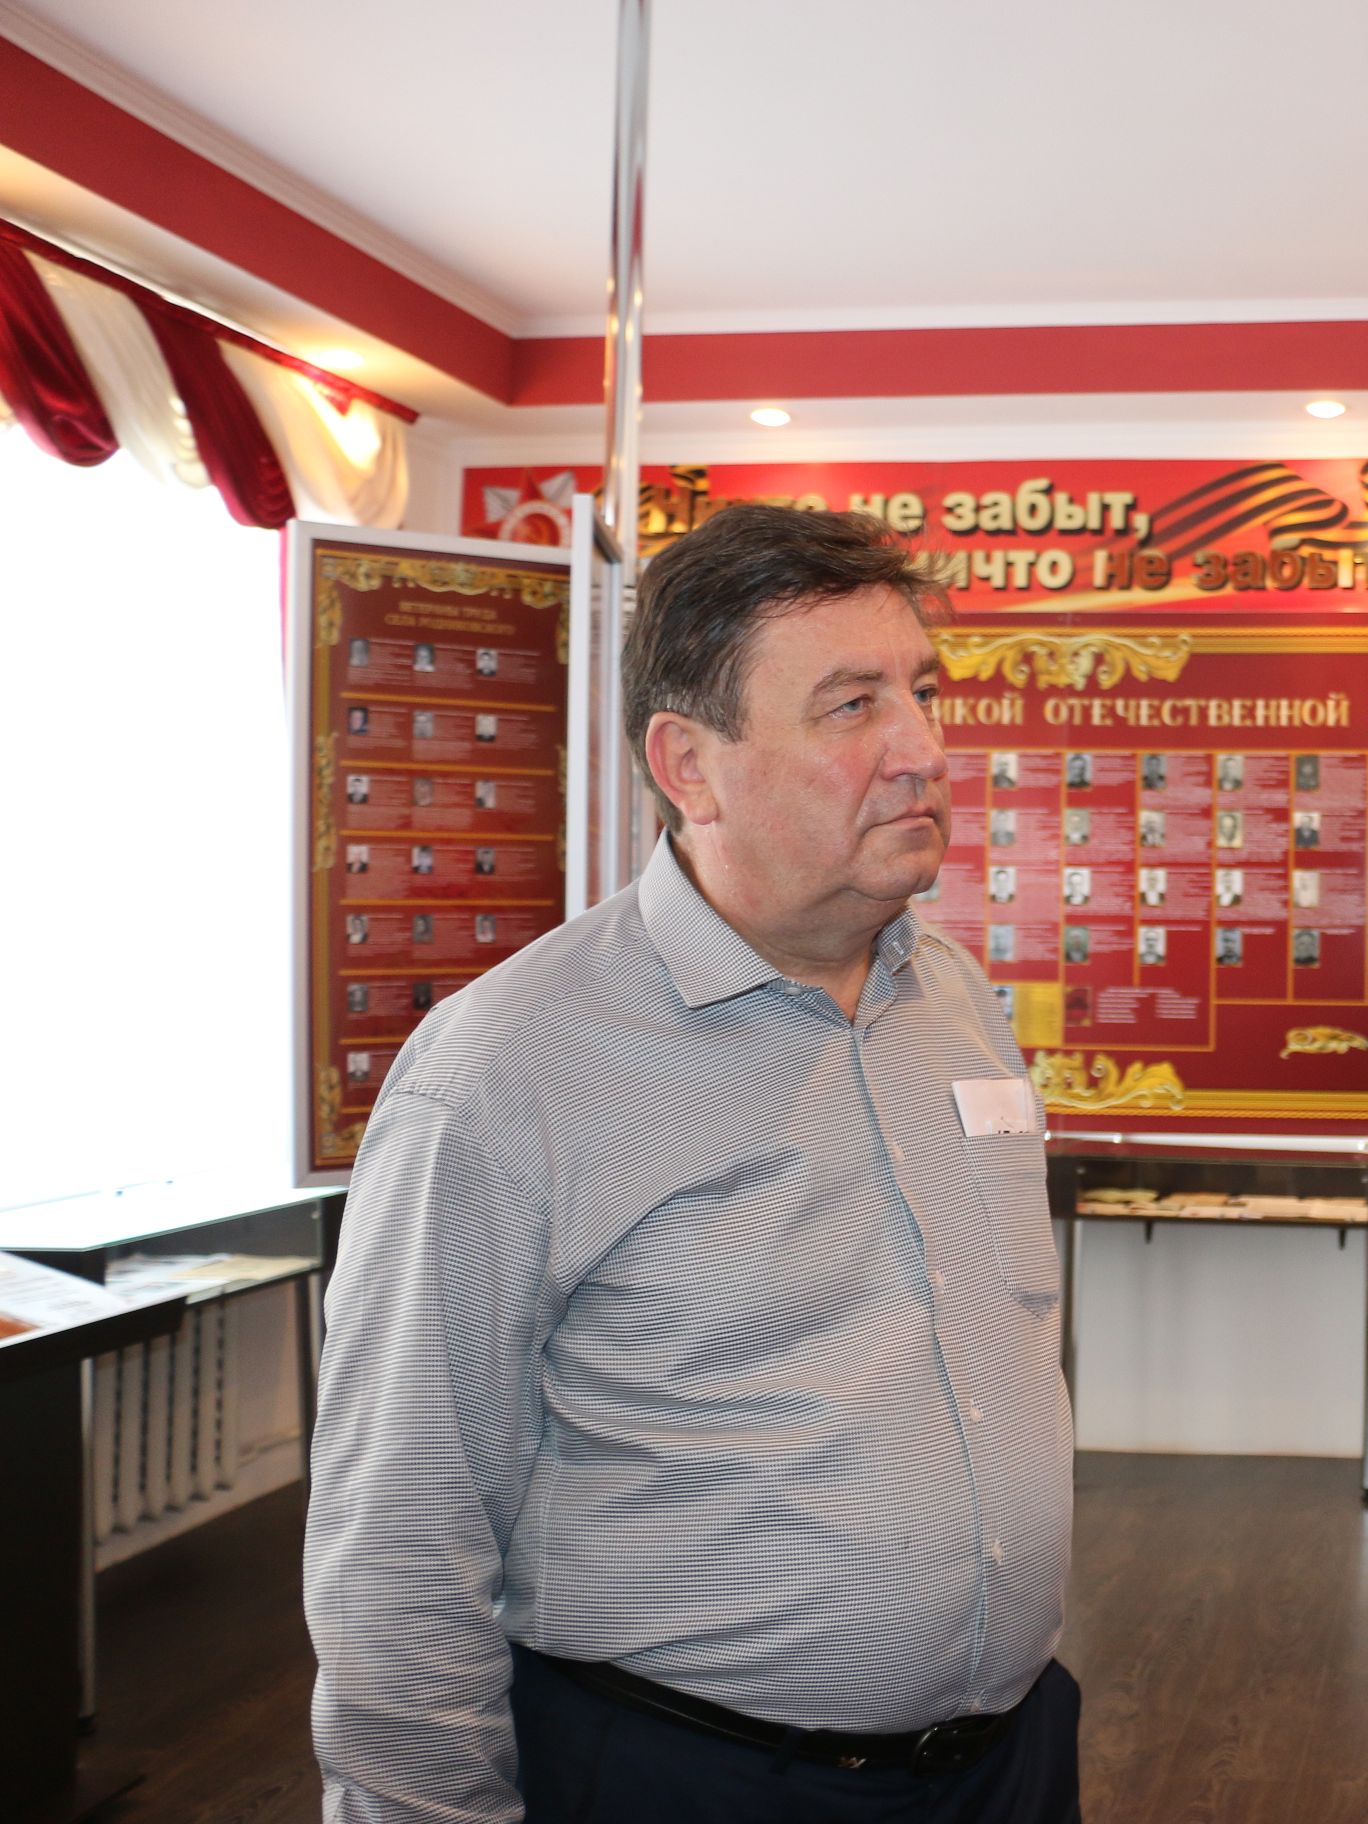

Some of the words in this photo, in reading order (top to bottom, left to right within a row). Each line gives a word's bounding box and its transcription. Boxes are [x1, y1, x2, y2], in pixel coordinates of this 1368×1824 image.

[942, 477, 1151, 539] забыт,
[1092, 549, 1169, 590] не
[1043, 691, 1350, 728] ОТЕЧЕСТВЕННОЙ
